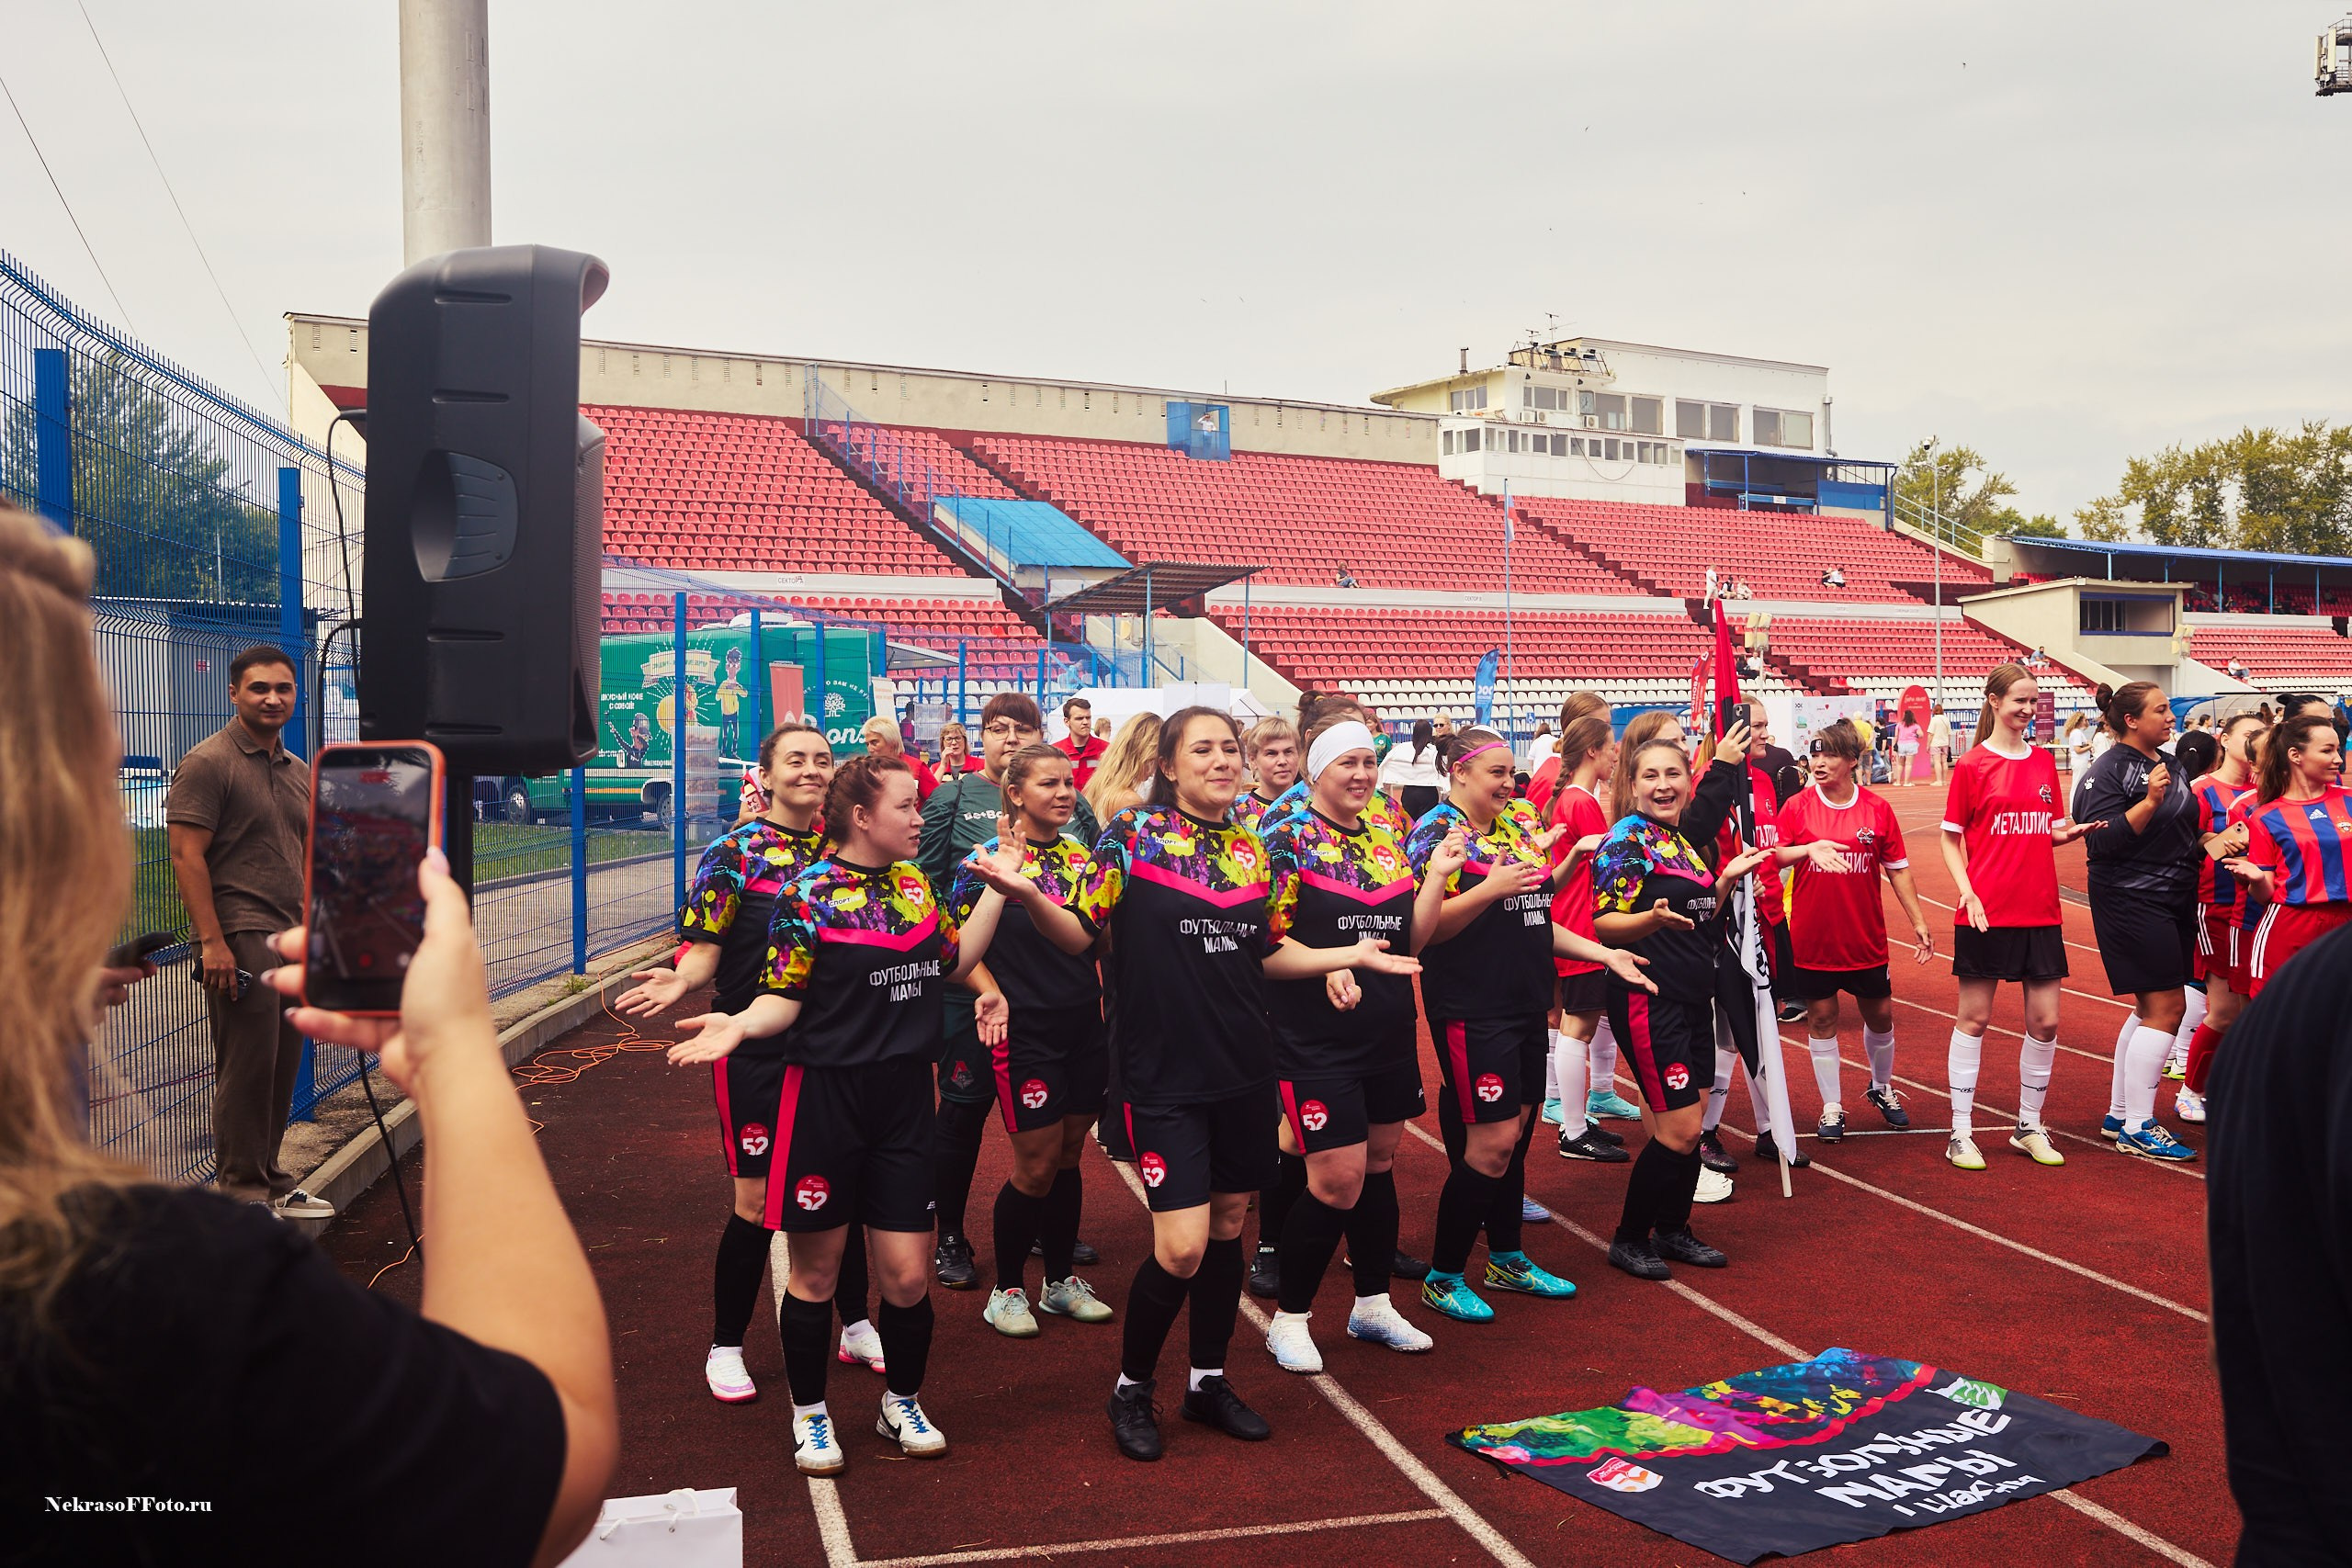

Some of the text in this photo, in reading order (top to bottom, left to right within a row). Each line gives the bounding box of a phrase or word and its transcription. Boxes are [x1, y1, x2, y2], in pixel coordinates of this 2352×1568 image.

[1234, 851, 1257, 870] 52
[1377, 855, 1396, 871] 52
[902, 887, 924, 905] 52
[1180, 919, 1258, 938] ФУТБОЛЬНЫЕ
[1338, 915, 1402, 931] ФУТБОЛЬНЫЕ
[1204, 935, 1238, 953] МАМЫ
[869, 959, 940, 987] ФУТБОЛЬНЫЕ
[889, 979, 922, 1002] МАМЫ
[1668, 1073, 1689, 1090] 52
[1023, 1091, 1047, 1109] 52
[1478, 1086, 1502, 1102] 52
[1303, 1112, 1327, 1131] 52
[743, 1136, 768, 1156] 52
[1143, 1168, 1164, 1187] 52
[797, 1190, 827, 1211] 52
[1815, 1450, 2018, 1508] МАМЫ
